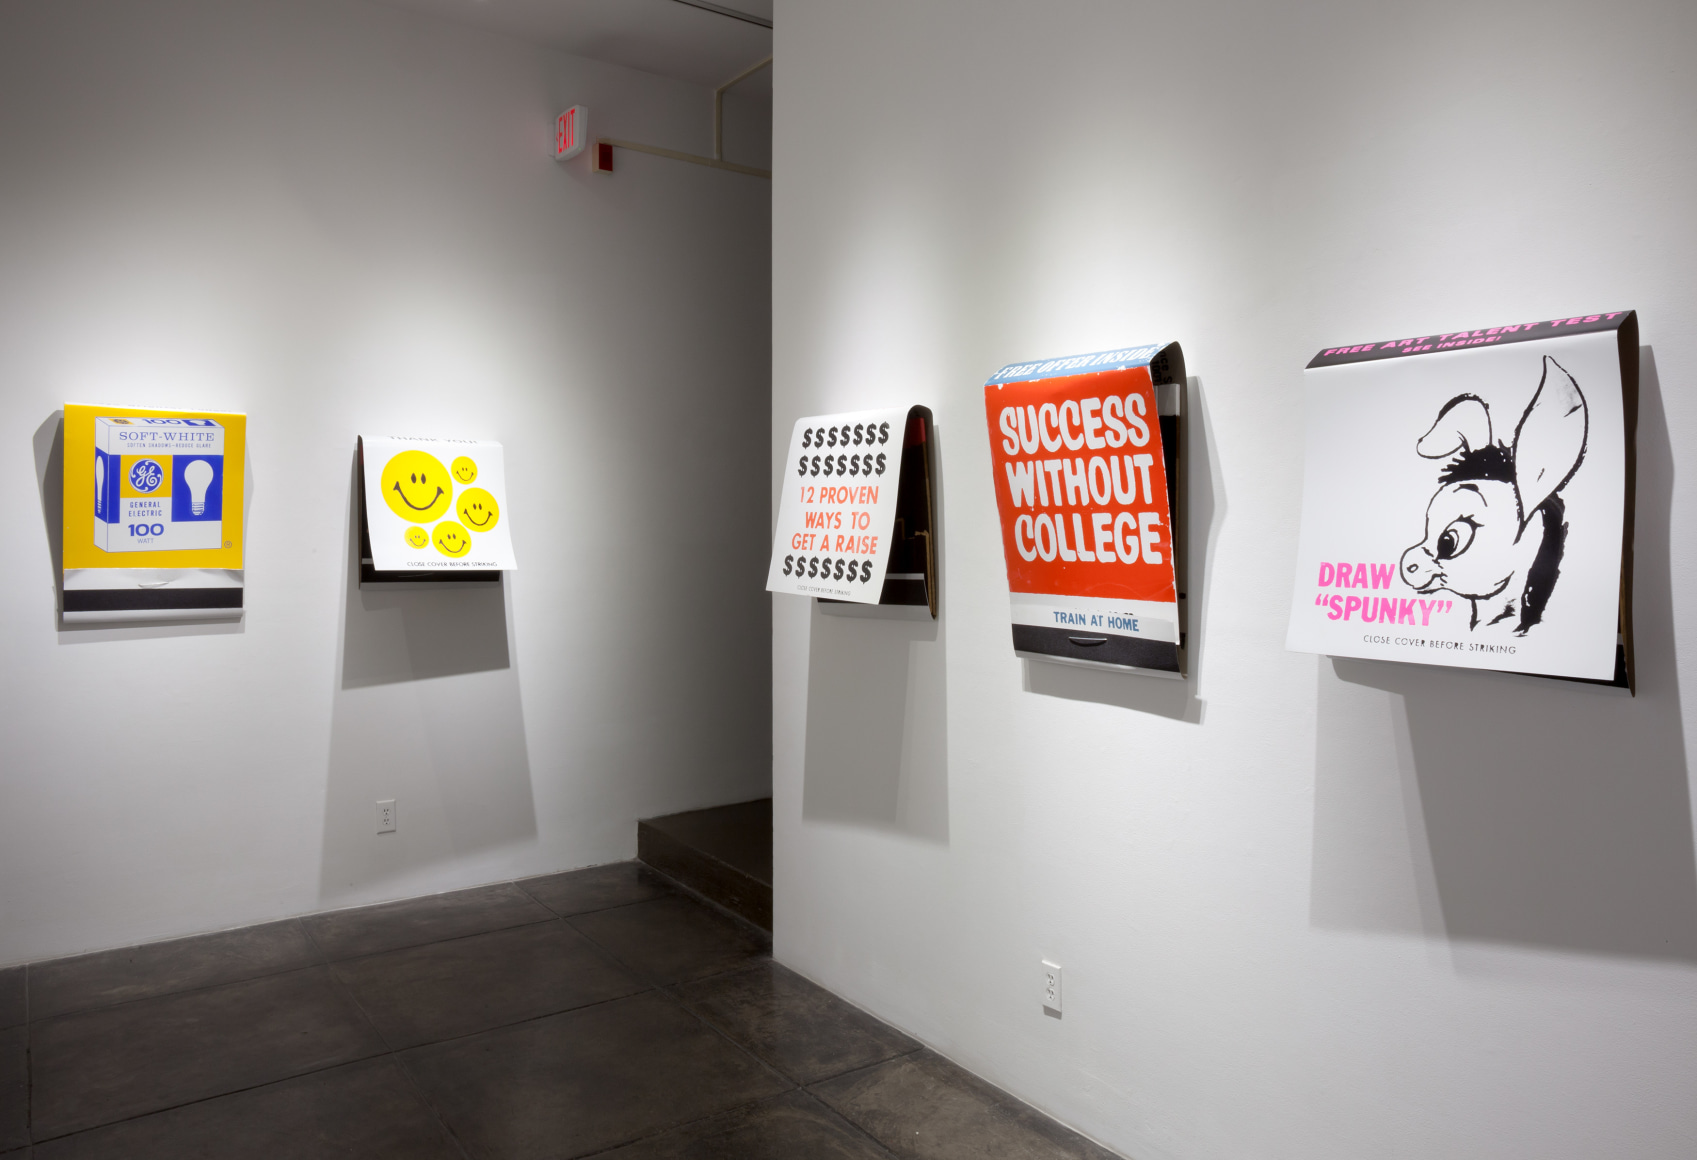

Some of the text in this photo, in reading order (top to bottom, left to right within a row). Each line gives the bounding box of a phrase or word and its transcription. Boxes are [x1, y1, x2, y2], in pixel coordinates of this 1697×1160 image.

[558, 108, 575, 154] EXIT
[1323, 312, 1623, 356] FREE ART TALENT TEST
[1401, 336, 1502, 353] SEE INSIDE!
[994, 362, 1043, 380] FREE
[1037, 354, 1093, 374] OFFER
[999, 393, 1150, 455] SUCCESS
[119, 432, 215, 441] SOFT-WHITE
[1005, 453, 1154, 508] WITHOUT
[800, 486, 879, 504] 12 PROVEN
[128, 523, 165, 537] 100
[805, 512, 871, 530] WAYS TO
[792, 533, 878, 554] GET A RAISE
[1014, 511, 1163, 565] COLLEGE
[1318, 562, 1396, 590] DRAW
[1315, 593, 1453, 626] “SPUNKY”
[1053, 611, 1086, 626] TRAIN
[1090, 615, 1104, 627] AT
[1107, 617, 1140, 632] HOME
[1363, 635, 1517, 655] CLOSE COVER BEFORE STRIKING
